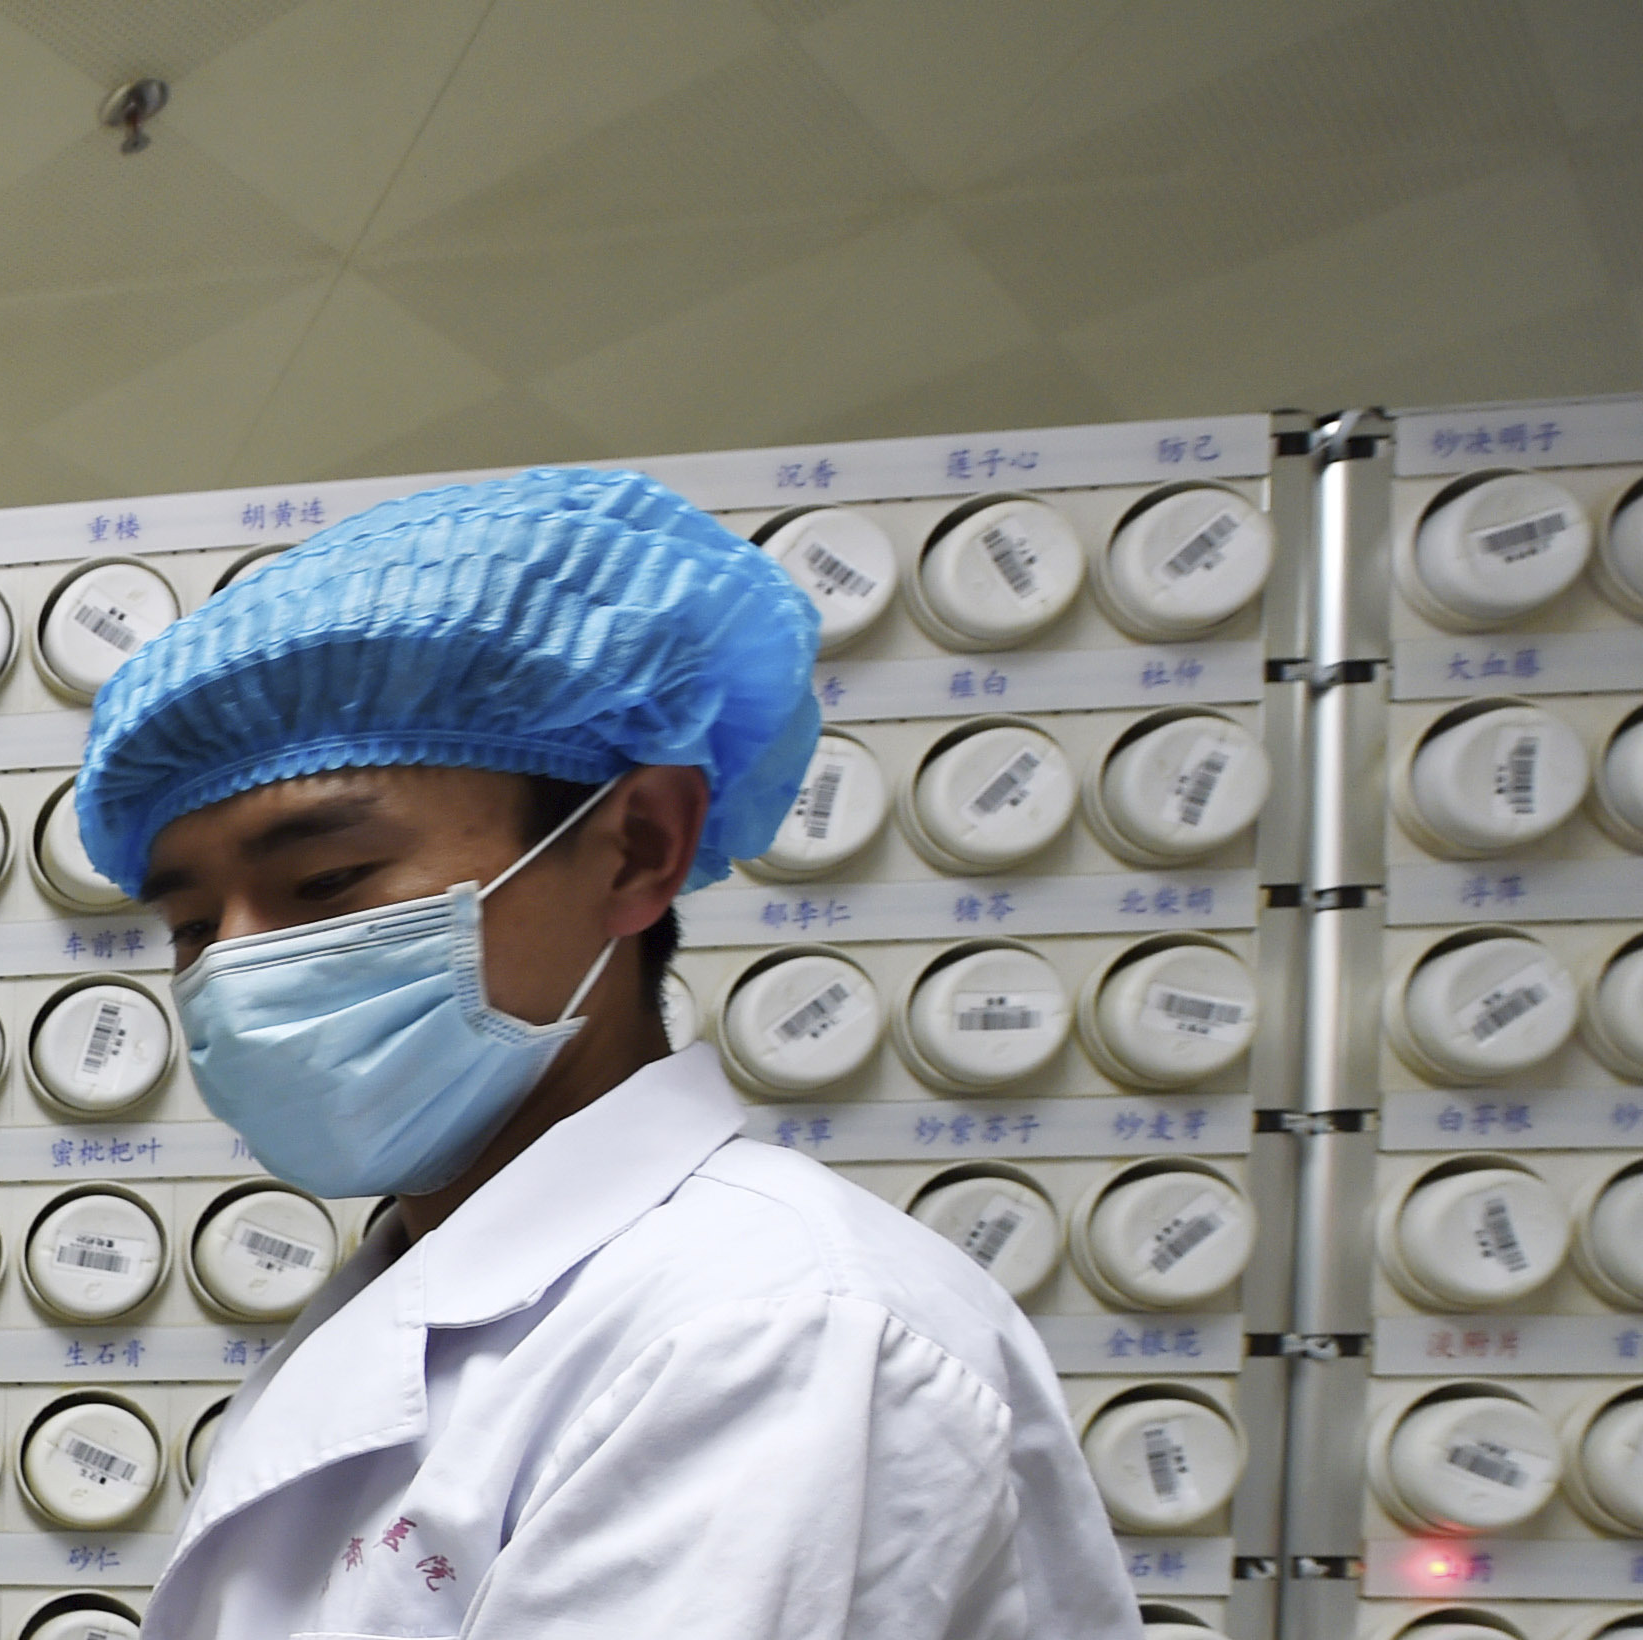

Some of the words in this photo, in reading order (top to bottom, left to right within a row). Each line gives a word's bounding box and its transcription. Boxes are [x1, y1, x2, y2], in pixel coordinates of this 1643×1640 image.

[947, 448, 1039, 479] 莲子心
[242, 497, 325, 528] 胡黄连
[88, 513, 141, 543] 重楼
[63, 931, 145, 960] 车前草
[51, 1137, 163, 1168] 蜜枇杷叶
[64, 1339, 145, 1368] 生石膏
[68, 1548, 120, 1572] 砂仁
